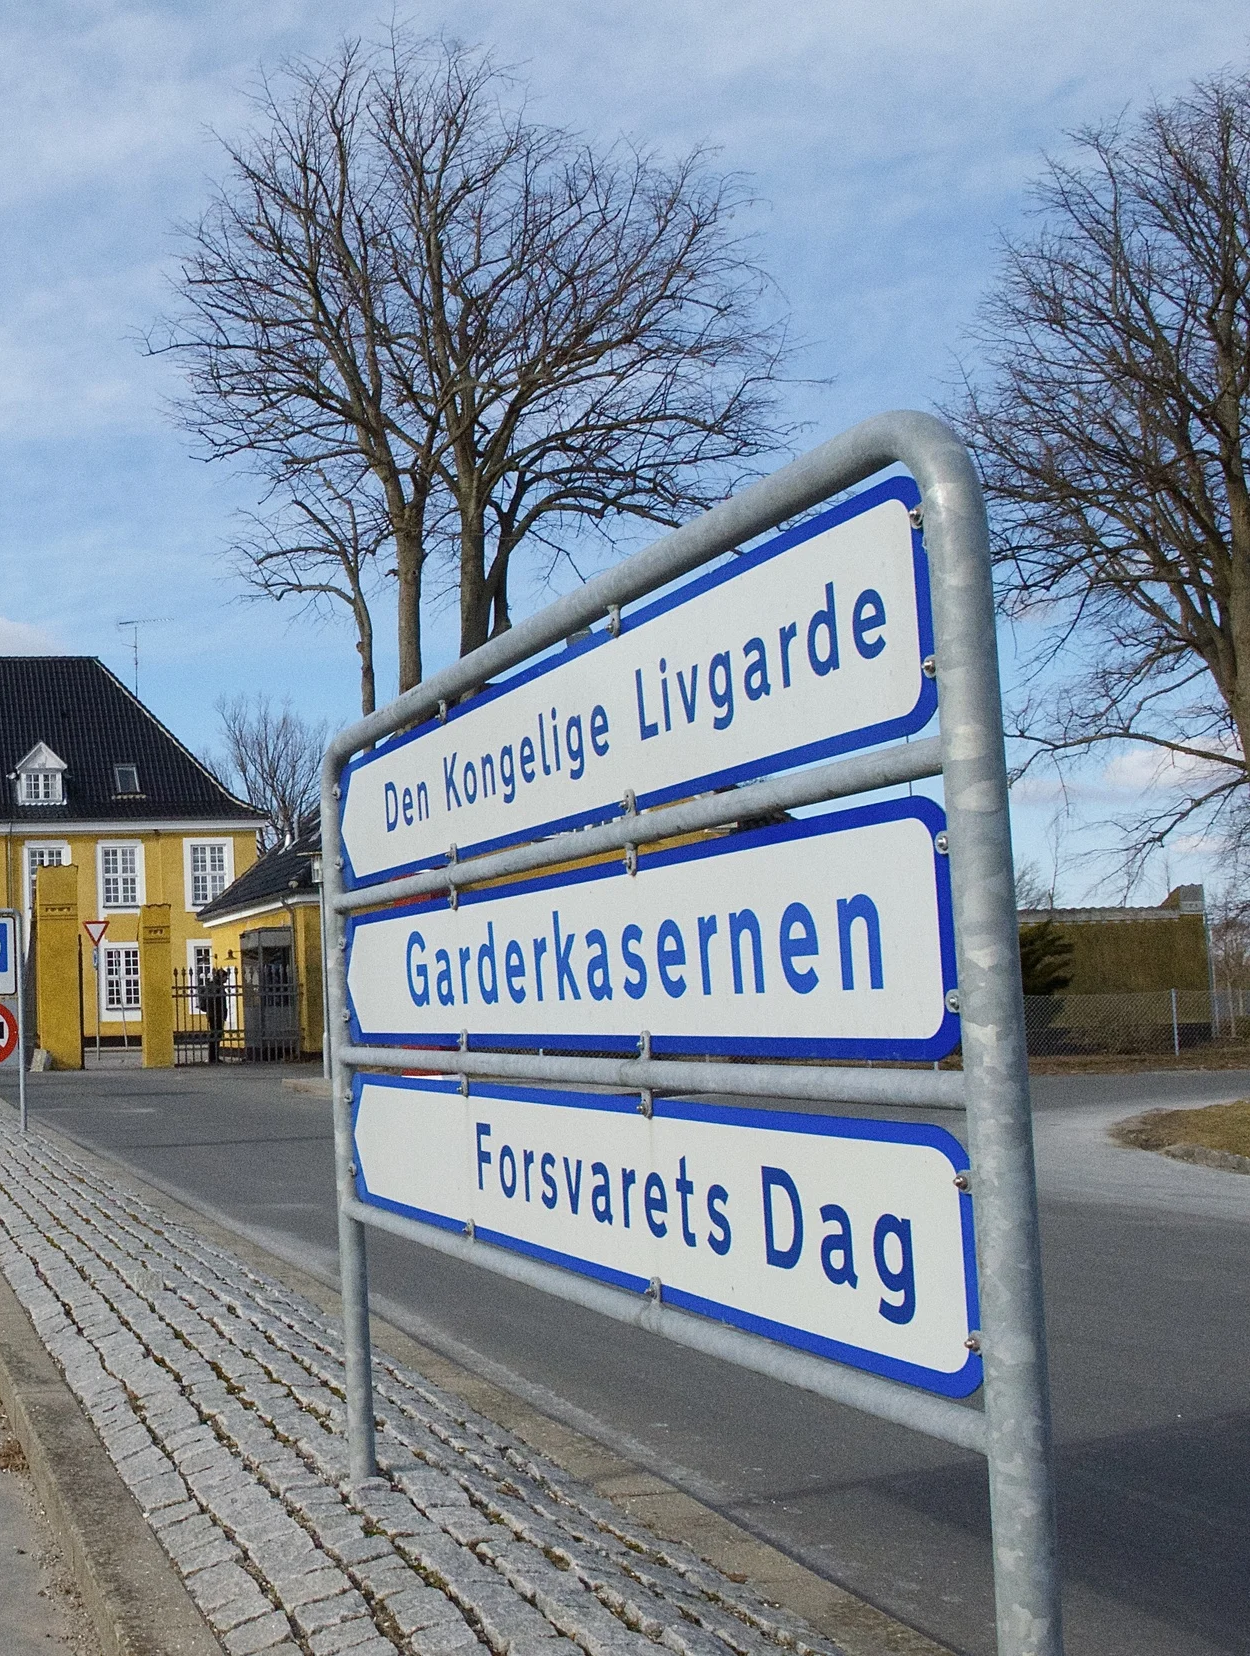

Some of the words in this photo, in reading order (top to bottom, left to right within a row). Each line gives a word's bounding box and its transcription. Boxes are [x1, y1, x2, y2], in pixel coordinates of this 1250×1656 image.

[384, 780, 431, 833] Den
[443, 703, 610, 809] Kongelige
[635, 581, 887, 741] Livgarde
[405, 892, 885, 1008] Garderkasernen
[476, 1122, 734, 1257] Forsvarets
[761, 1165, 917, 1326] Dag
